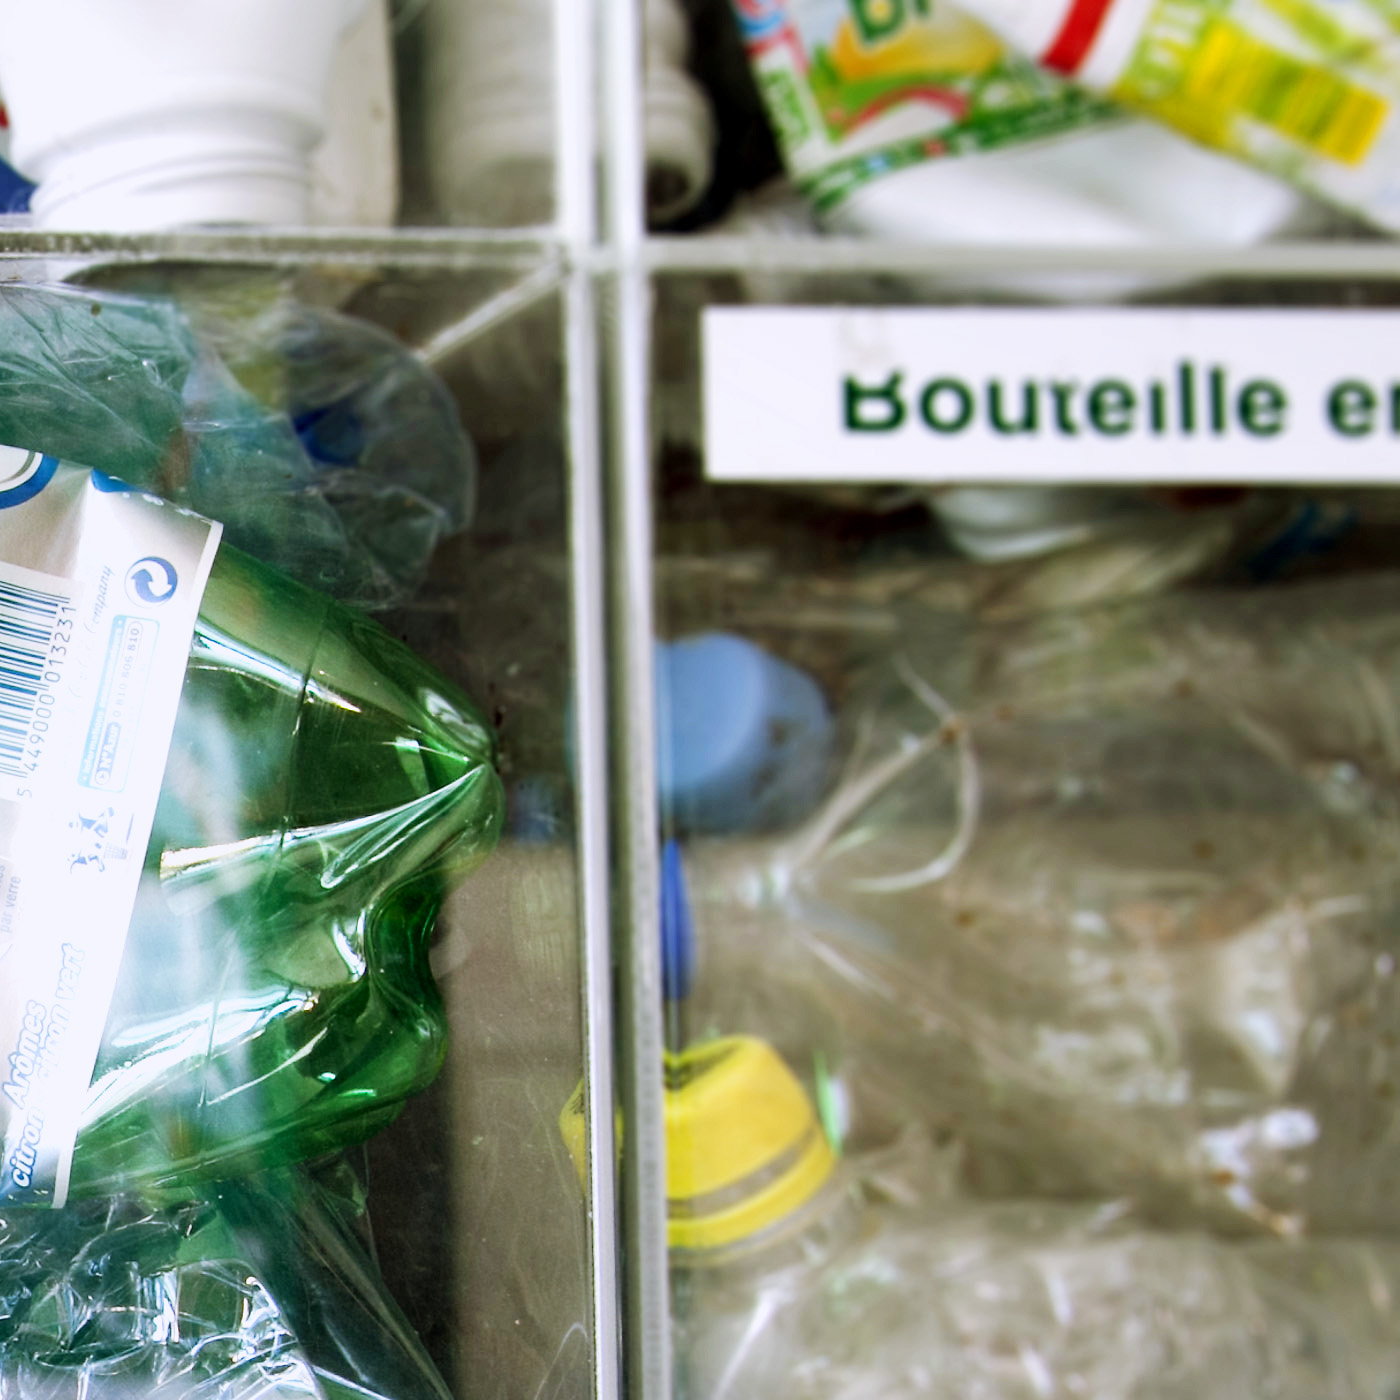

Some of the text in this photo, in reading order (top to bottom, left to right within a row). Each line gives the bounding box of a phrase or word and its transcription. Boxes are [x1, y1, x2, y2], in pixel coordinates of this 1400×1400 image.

[1325, 375, 1400, 436] e
[45, 606, 76, 682] 013231
[24, 694, 55, 771] 449000
[4, 1105, 49, 1188] citron
[48, 941, 88, 1001] vert
